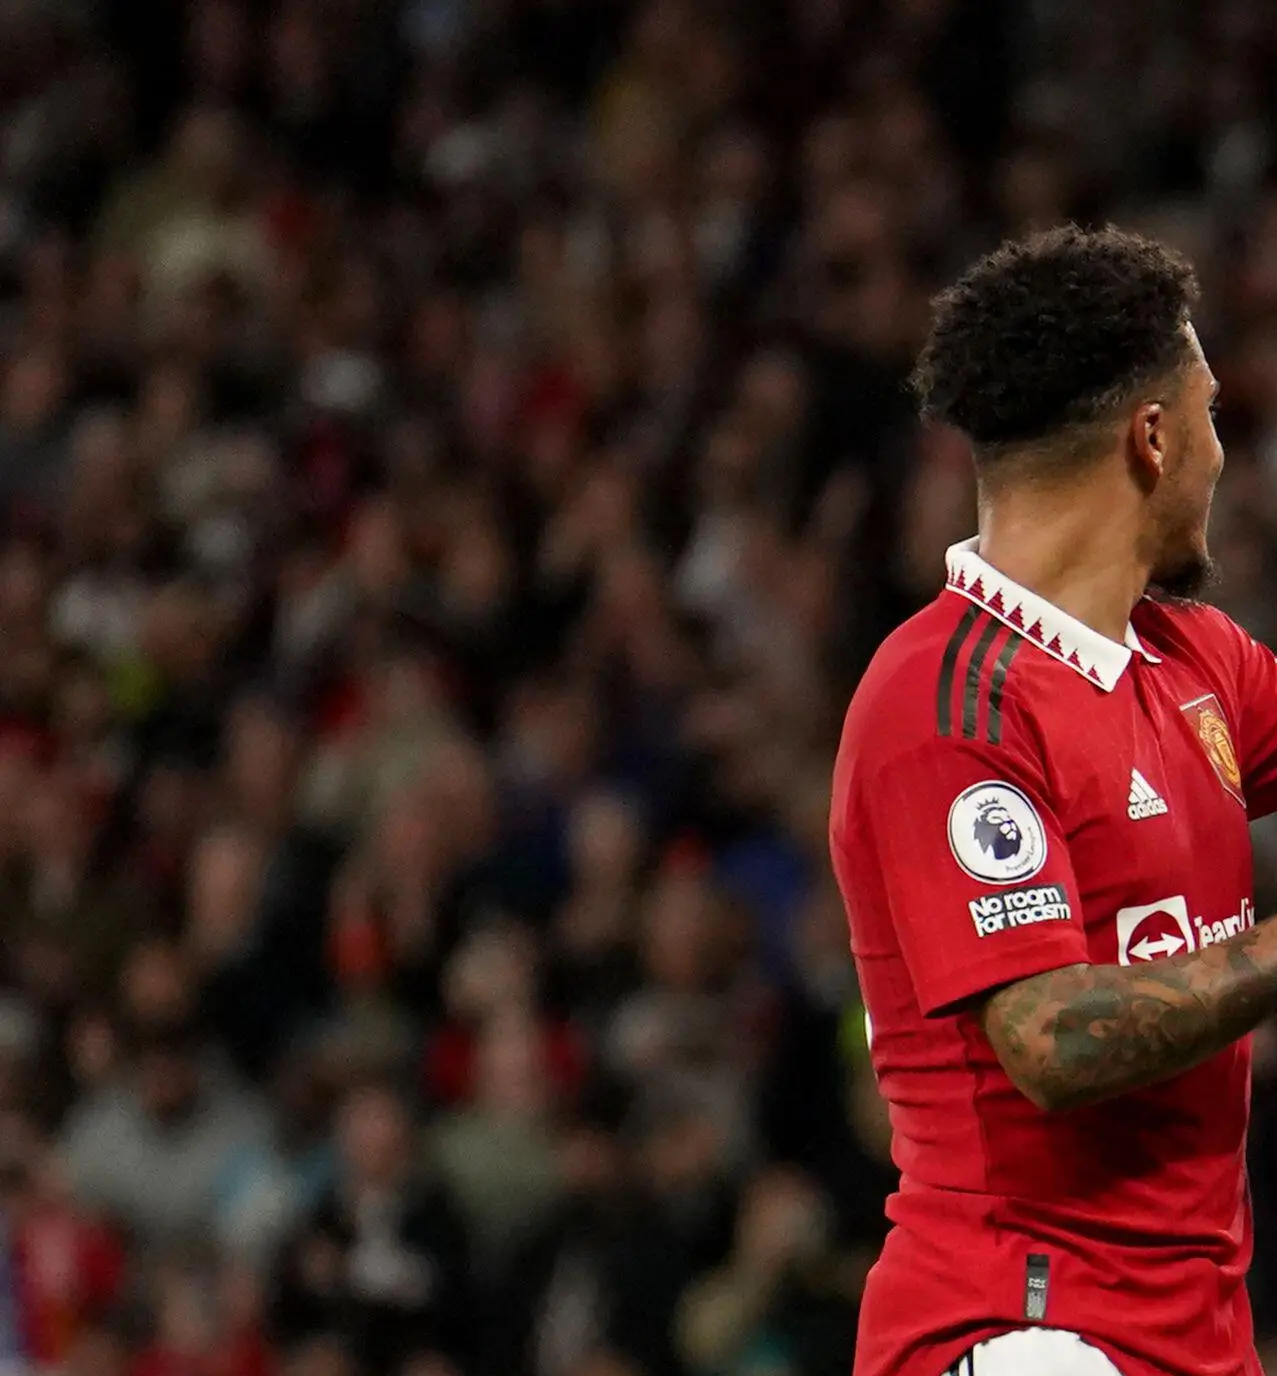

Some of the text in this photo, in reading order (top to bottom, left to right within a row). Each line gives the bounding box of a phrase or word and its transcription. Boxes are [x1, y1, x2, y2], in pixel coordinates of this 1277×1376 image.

[1128, 798, 1168, 820] adidas
[969, 887, 1062, 918] No room
[974, 902, 1072, 938] for racism
